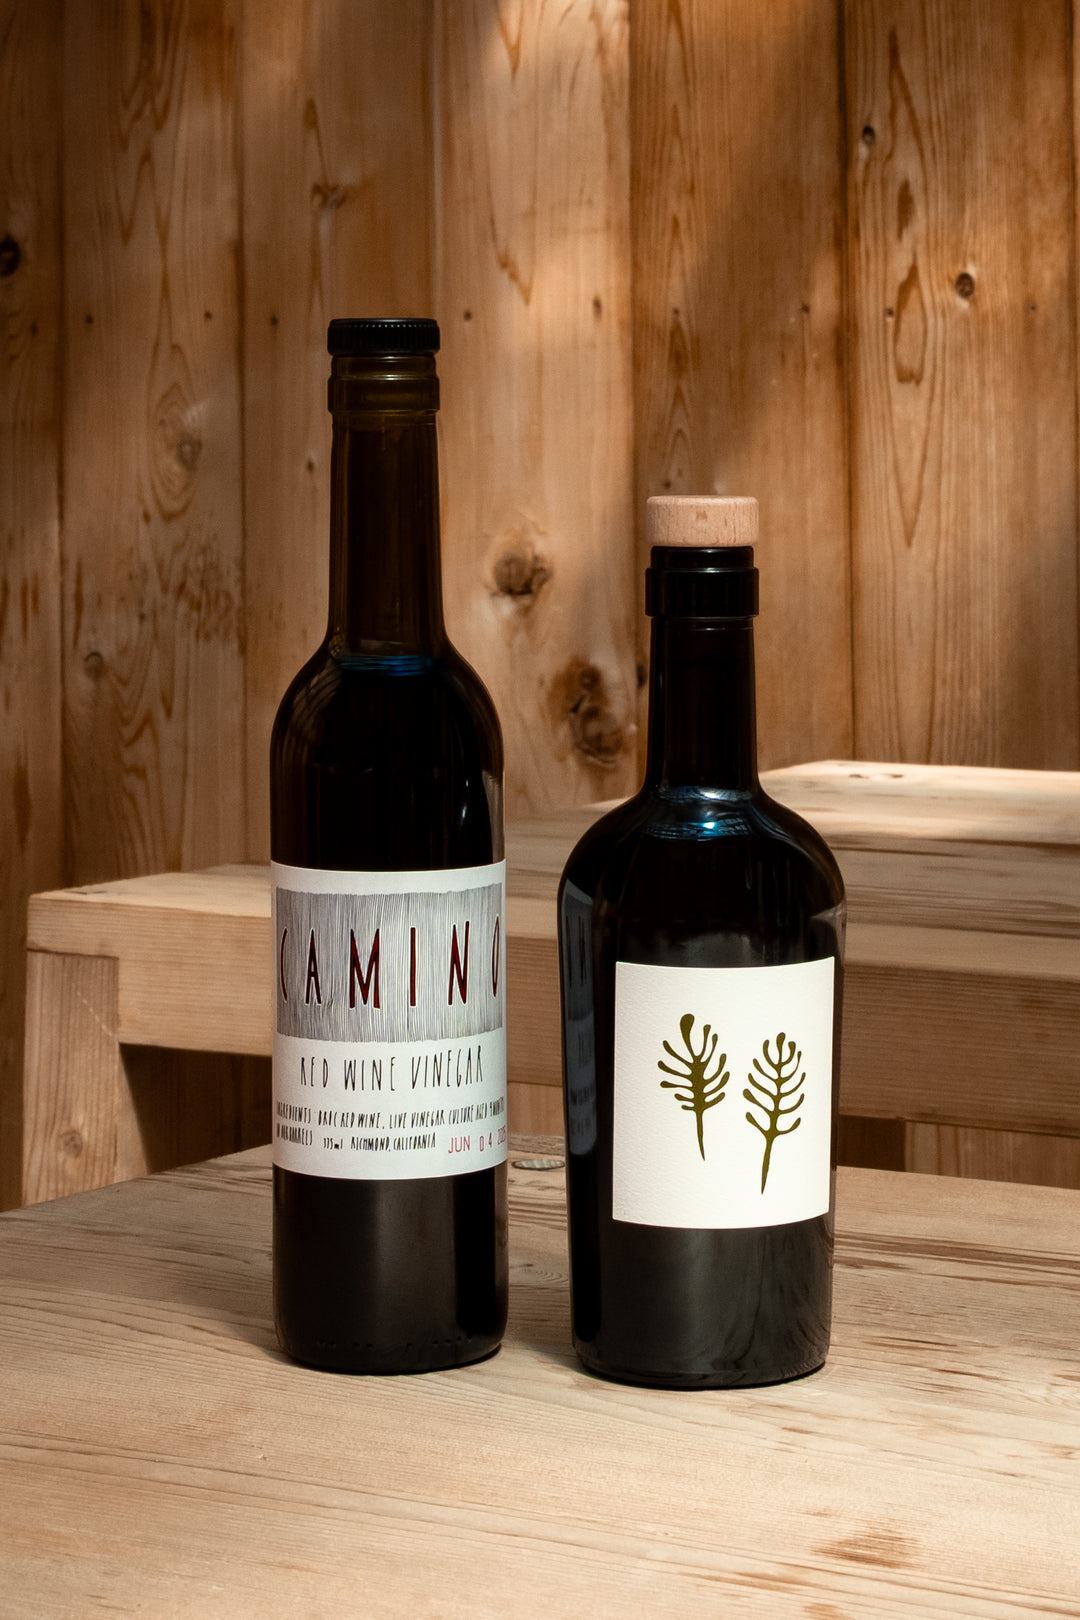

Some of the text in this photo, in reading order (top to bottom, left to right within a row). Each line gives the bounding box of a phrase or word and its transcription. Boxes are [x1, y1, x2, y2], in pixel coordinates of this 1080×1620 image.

[280, 916, 500, 1009] CAMINO
[300, 1045, 484, 1092] RED WINE VINEGAR
[389, 1112, 407, 1129] LIVE
[411, 1109, 445, 1128] VINEGAR
[448, 1104, 475, 1125] CULTURE
[393, 1132, 436, 1151] CALIFORNIA
[448, 1135, 471, 1154] JUN
